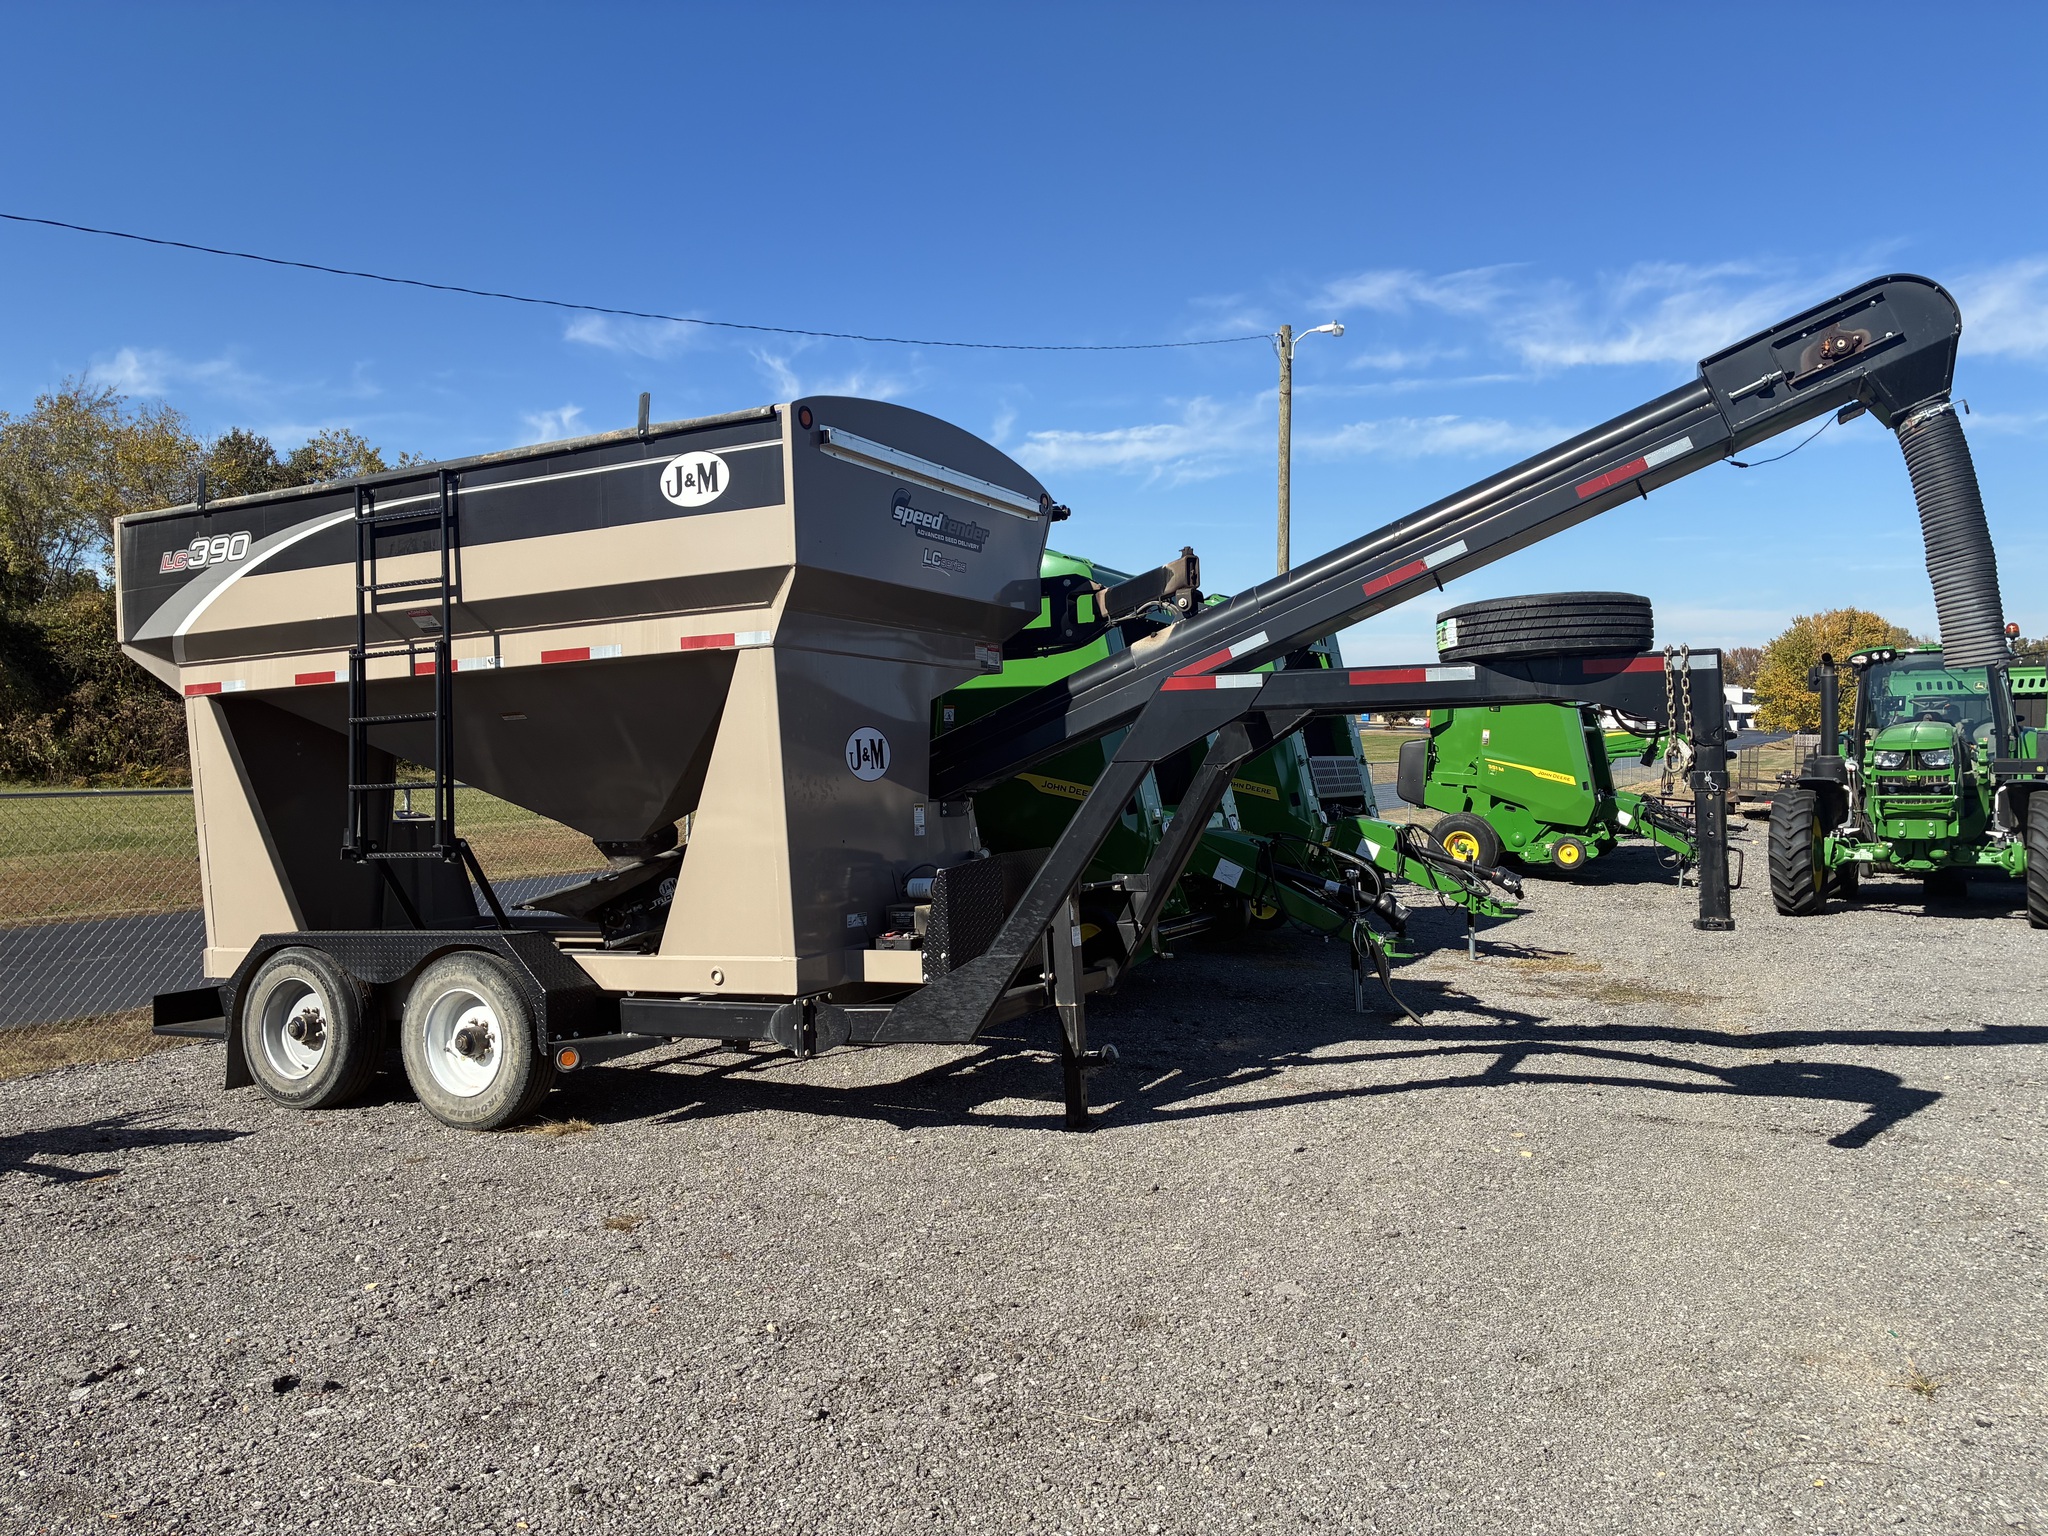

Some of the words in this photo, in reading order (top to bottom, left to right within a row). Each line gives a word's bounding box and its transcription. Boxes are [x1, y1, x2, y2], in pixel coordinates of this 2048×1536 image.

[666, 461, 719, 498] J&M
[917, 529, 944, 541] ADVANCED
[945, 536, 958, 544] SEED
[958, 539, 980, 550] DELIVERY
[849, 738, 885, 770] J&M
[1538, 770, 1552, 778] JOHN
[1553, 774, 1571, 782] DEERE
[1041, 781, 1067, 792] JOHN
[1069, 786, 1089, 797] DEE
[1245, 783, 1272, 795] DEERE
